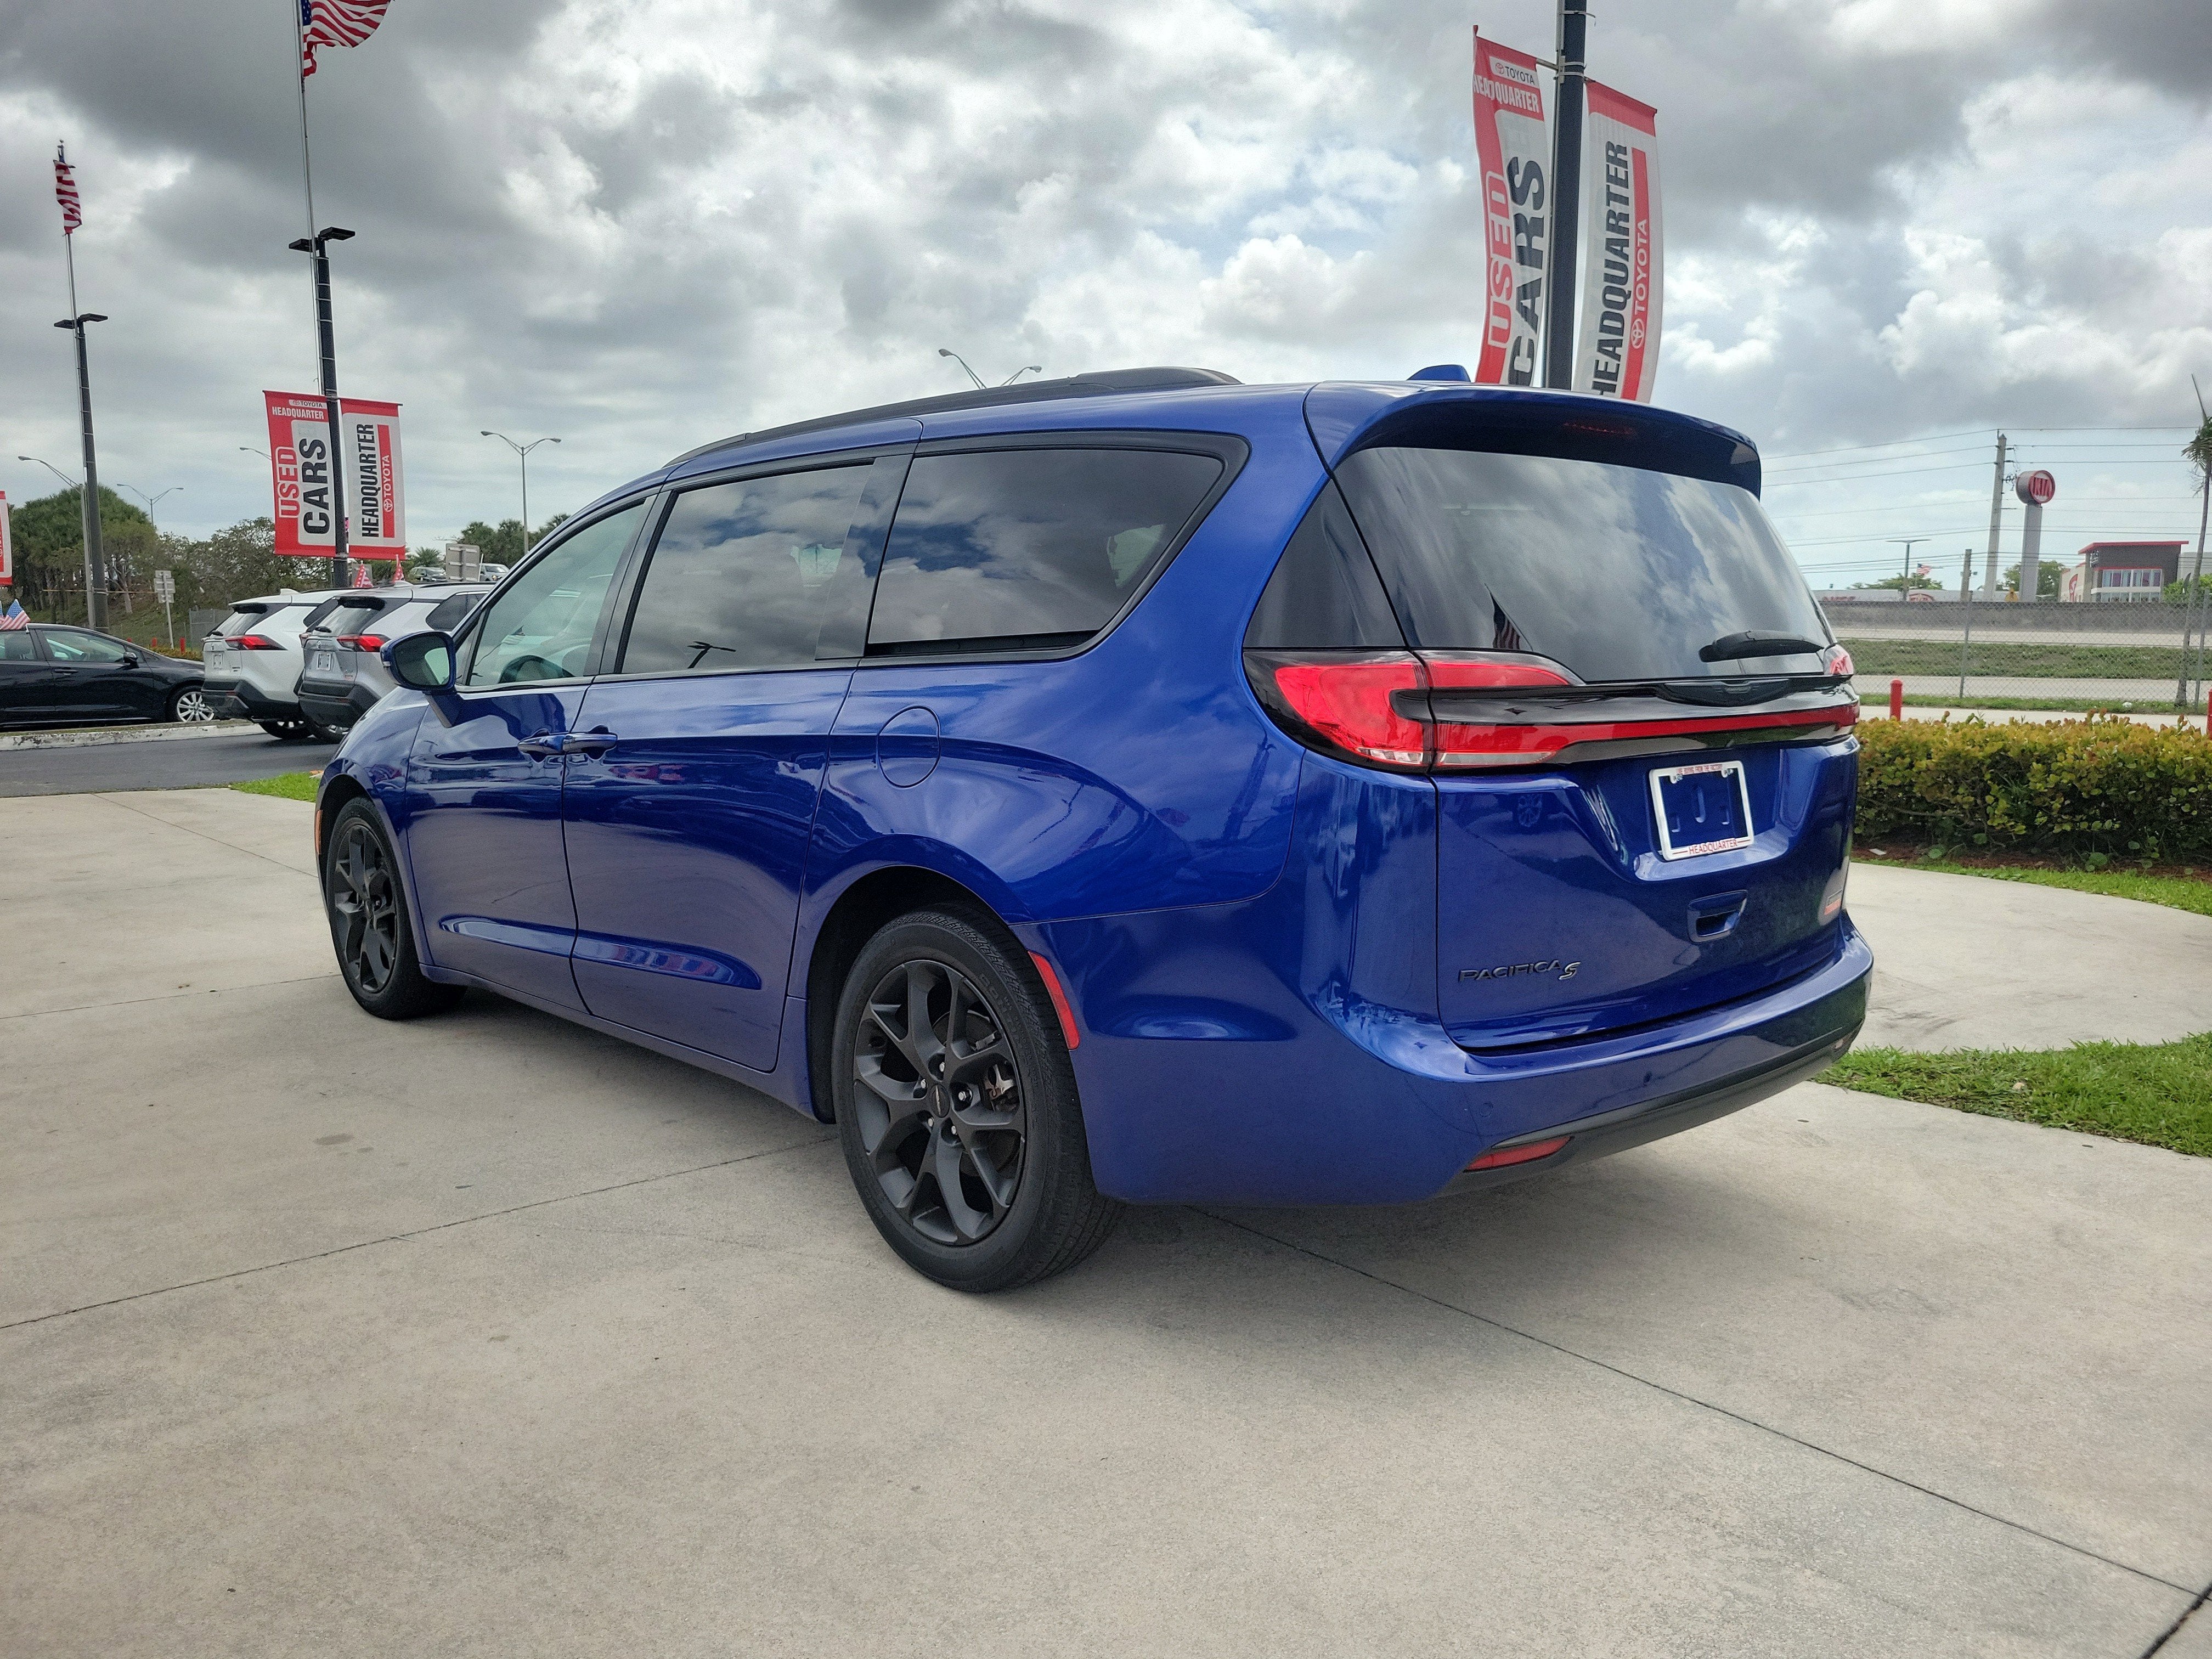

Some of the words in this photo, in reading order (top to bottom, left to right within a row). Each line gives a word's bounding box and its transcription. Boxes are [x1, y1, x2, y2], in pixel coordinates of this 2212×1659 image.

[1472, 74, 1540, 113] HEADQUARTER
[1505, 66, 1536, 86] TOYOTA
[1486, 171, 1513, 349] USED
[1507, 156, 1544, 386] CARS
[1635, 219, 1647, 315] TOYOTA
[272, 406, 325, 420] HEADQUARTER
[275, 446, 301, 518] USED
[299, 438, 330, 534] CARS
[357, 424, 381, 538] HEADQUARTER
[382, 455, 391, 499] TOYOTA
[1689, 838, 1738, 855] HEADQUARTER
[1458, 959, 1561, 983] PACIFICA
[1558, 961, 1581, 980] S
